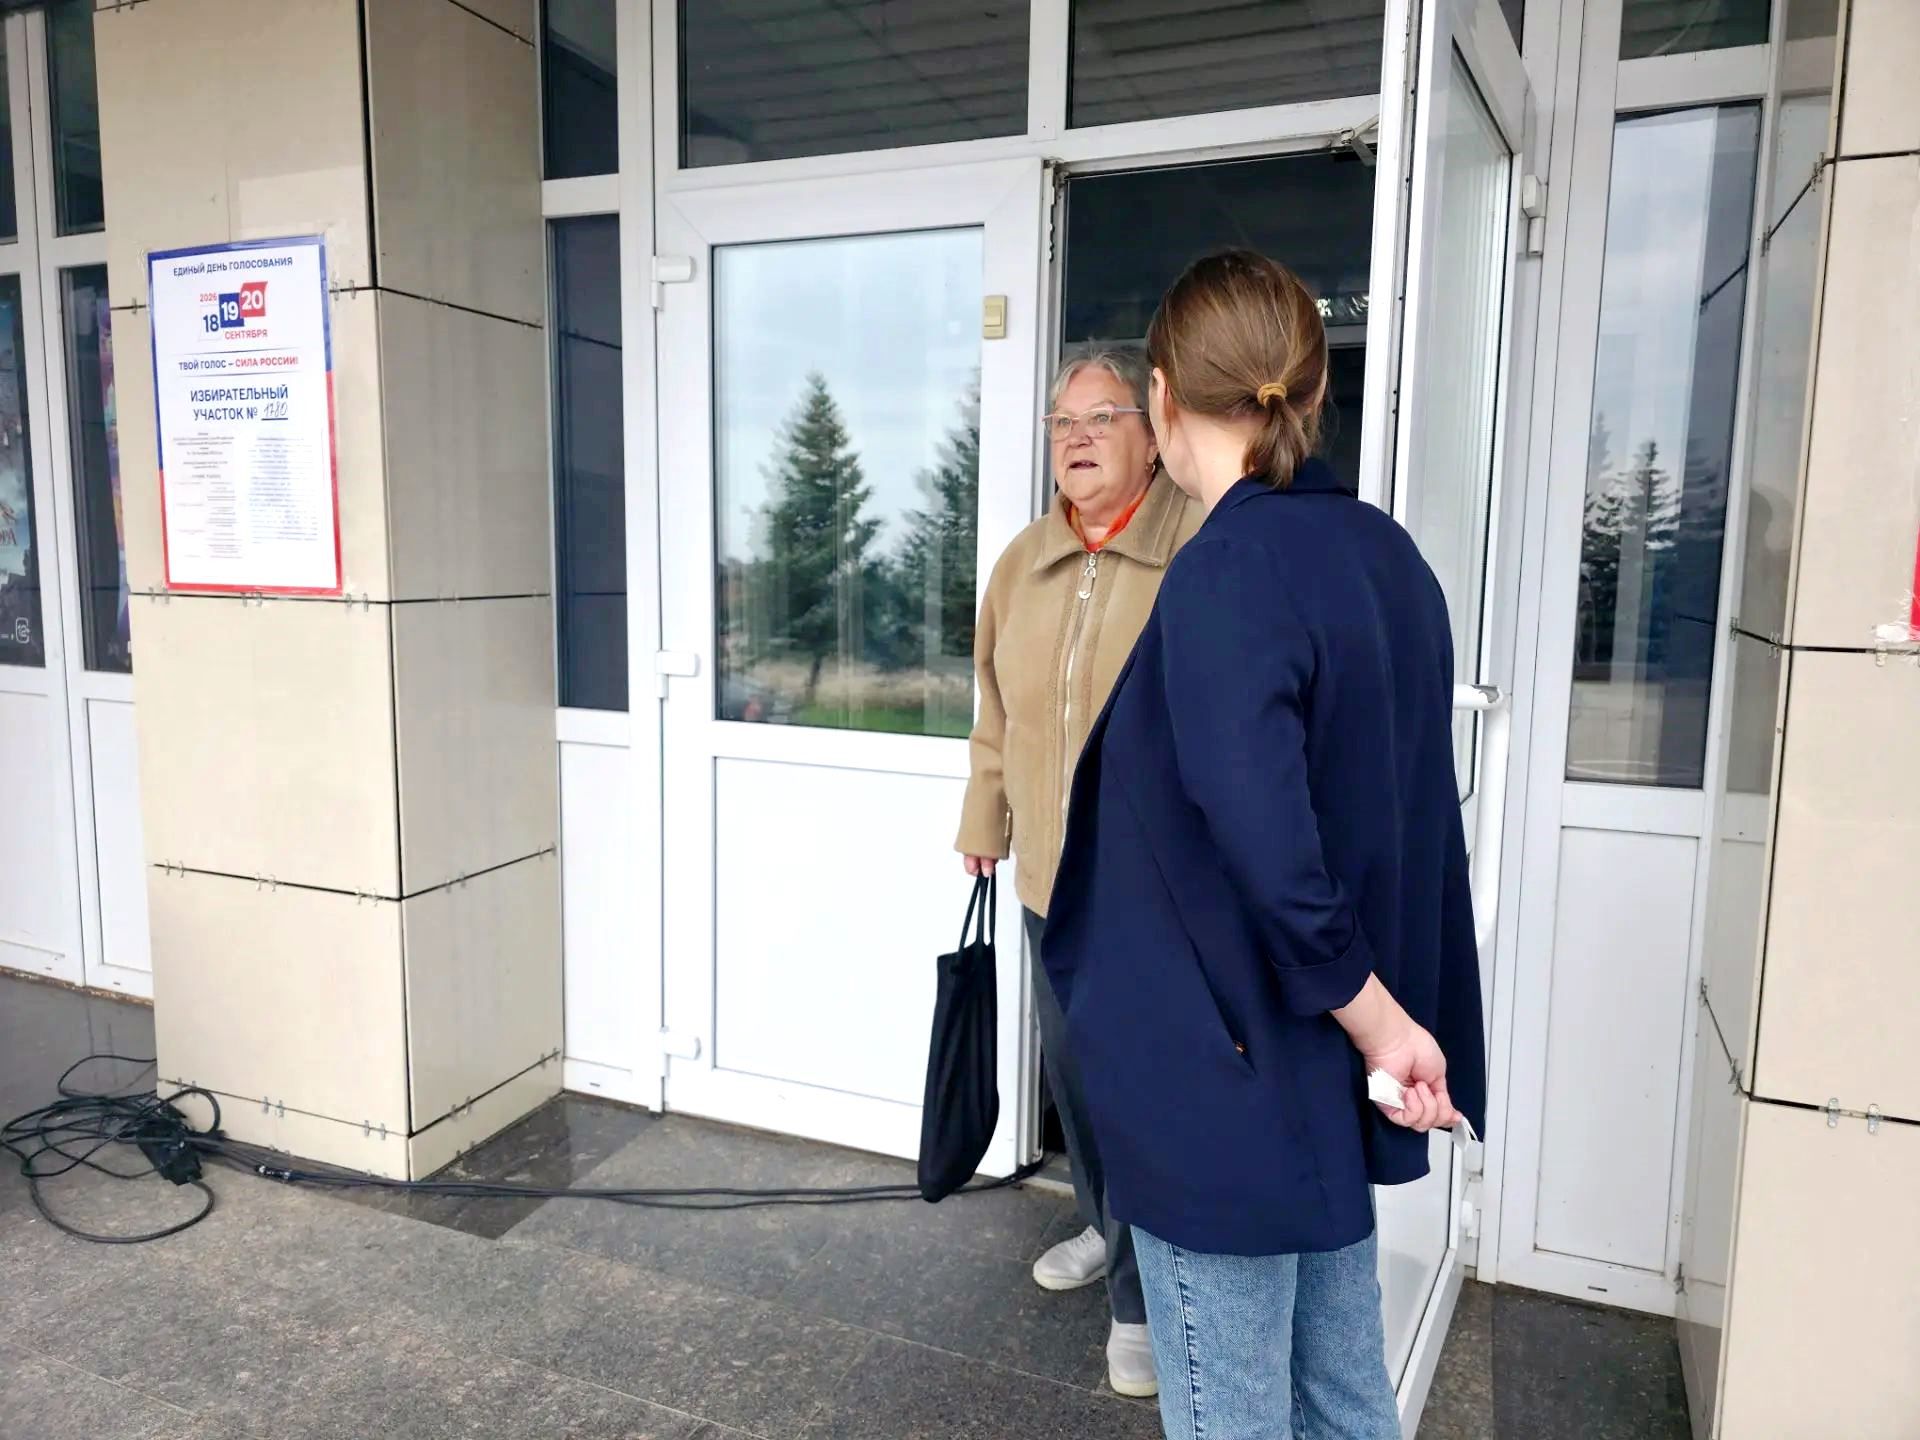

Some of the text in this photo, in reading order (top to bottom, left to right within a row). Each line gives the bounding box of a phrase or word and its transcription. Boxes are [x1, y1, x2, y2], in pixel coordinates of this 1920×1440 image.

[173, 257, 293, 276] ЕДИНЫЙ ДЕНЬ ГОЛОСОВАНИЯ
[200, 293, 217, 302] 2026
[241, 290, 263, 310] 20
[221, 301, 239, 321] 19
[203, 314, 219, 333] 18
[225, 329, 268, 340] СЕНТЯБРЯ
[179, 360, 199, 370] ТВОЙ
[201, 359, 226, 369] ГОЛОС
[235, 358, 258, 368] СИЛА
[260, 356, 298, 366] РОССИИ!
[190, 384, 289, 402] ИЗБИРАТЕЛЬНЫЙ
[193, 406, 258, 421] УЧАСТОК №
